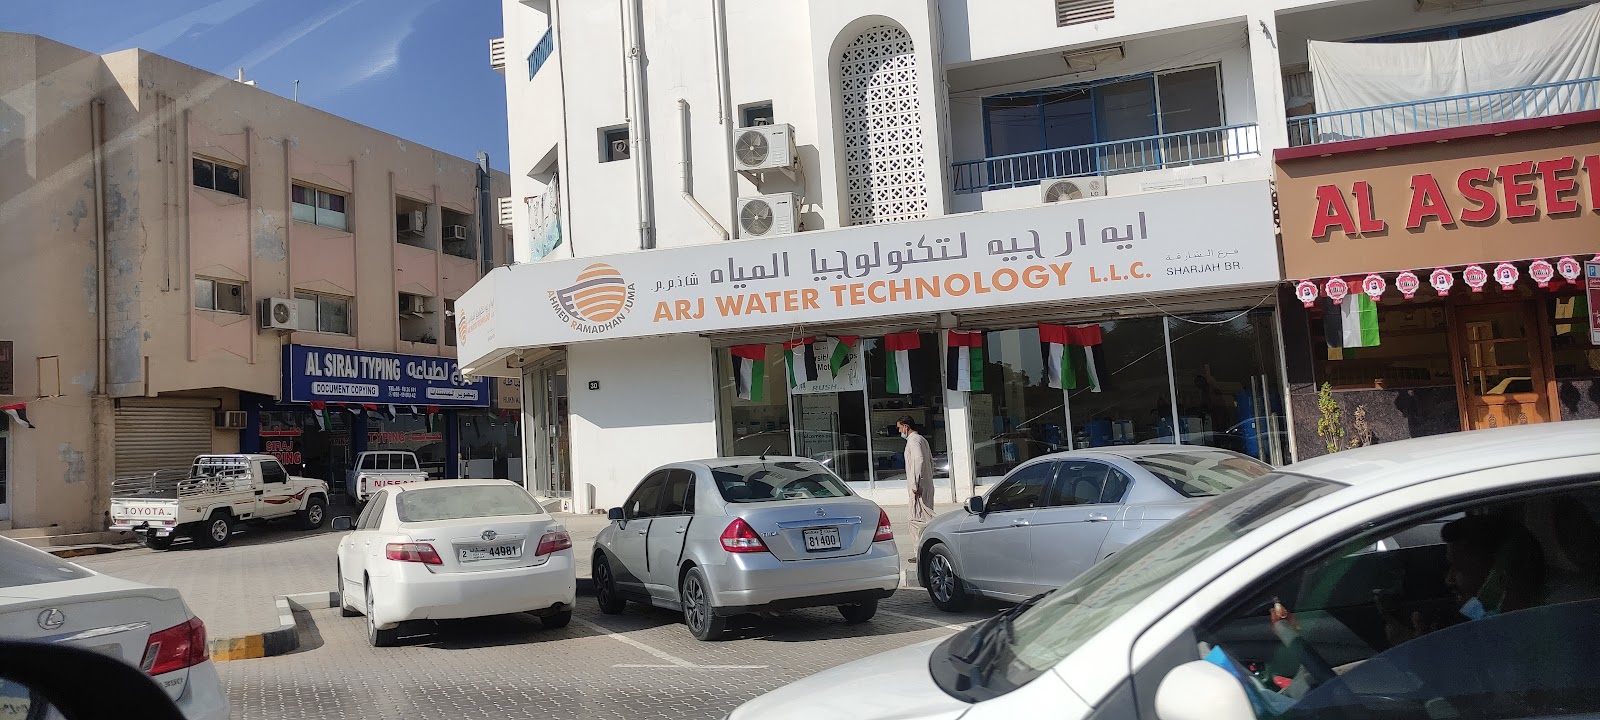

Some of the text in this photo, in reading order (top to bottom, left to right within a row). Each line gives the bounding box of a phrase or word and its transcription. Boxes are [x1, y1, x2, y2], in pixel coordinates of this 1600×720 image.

[1311, 180, 1384, 238] AL
[810, 231, 968, 282] لتكنولوجيا
[710, 251, 790, 289] المياه
[1166, 261, 1244, 276] SHARJAH BR.
[653, 261, 1152, 323] ARJ WATER TECHNOLOGY L.L.C.
[547, 282, 636, 334] AHMED RAMADHAN JUMA
[305, 351, 401, 382] AL SIRAJ TYPING
[316, 384, 376, 395] DOCUMENT COPYING
[368, 430, 406, 444] TYPING
[265, 440, 294, 452] SIRAJ
[124, 507, 165, 516] TOYOTA
[809, 534, 836, 547] 81400
[462, 550, 467, 558] 2
[489, 545, 516, 557] 44981
